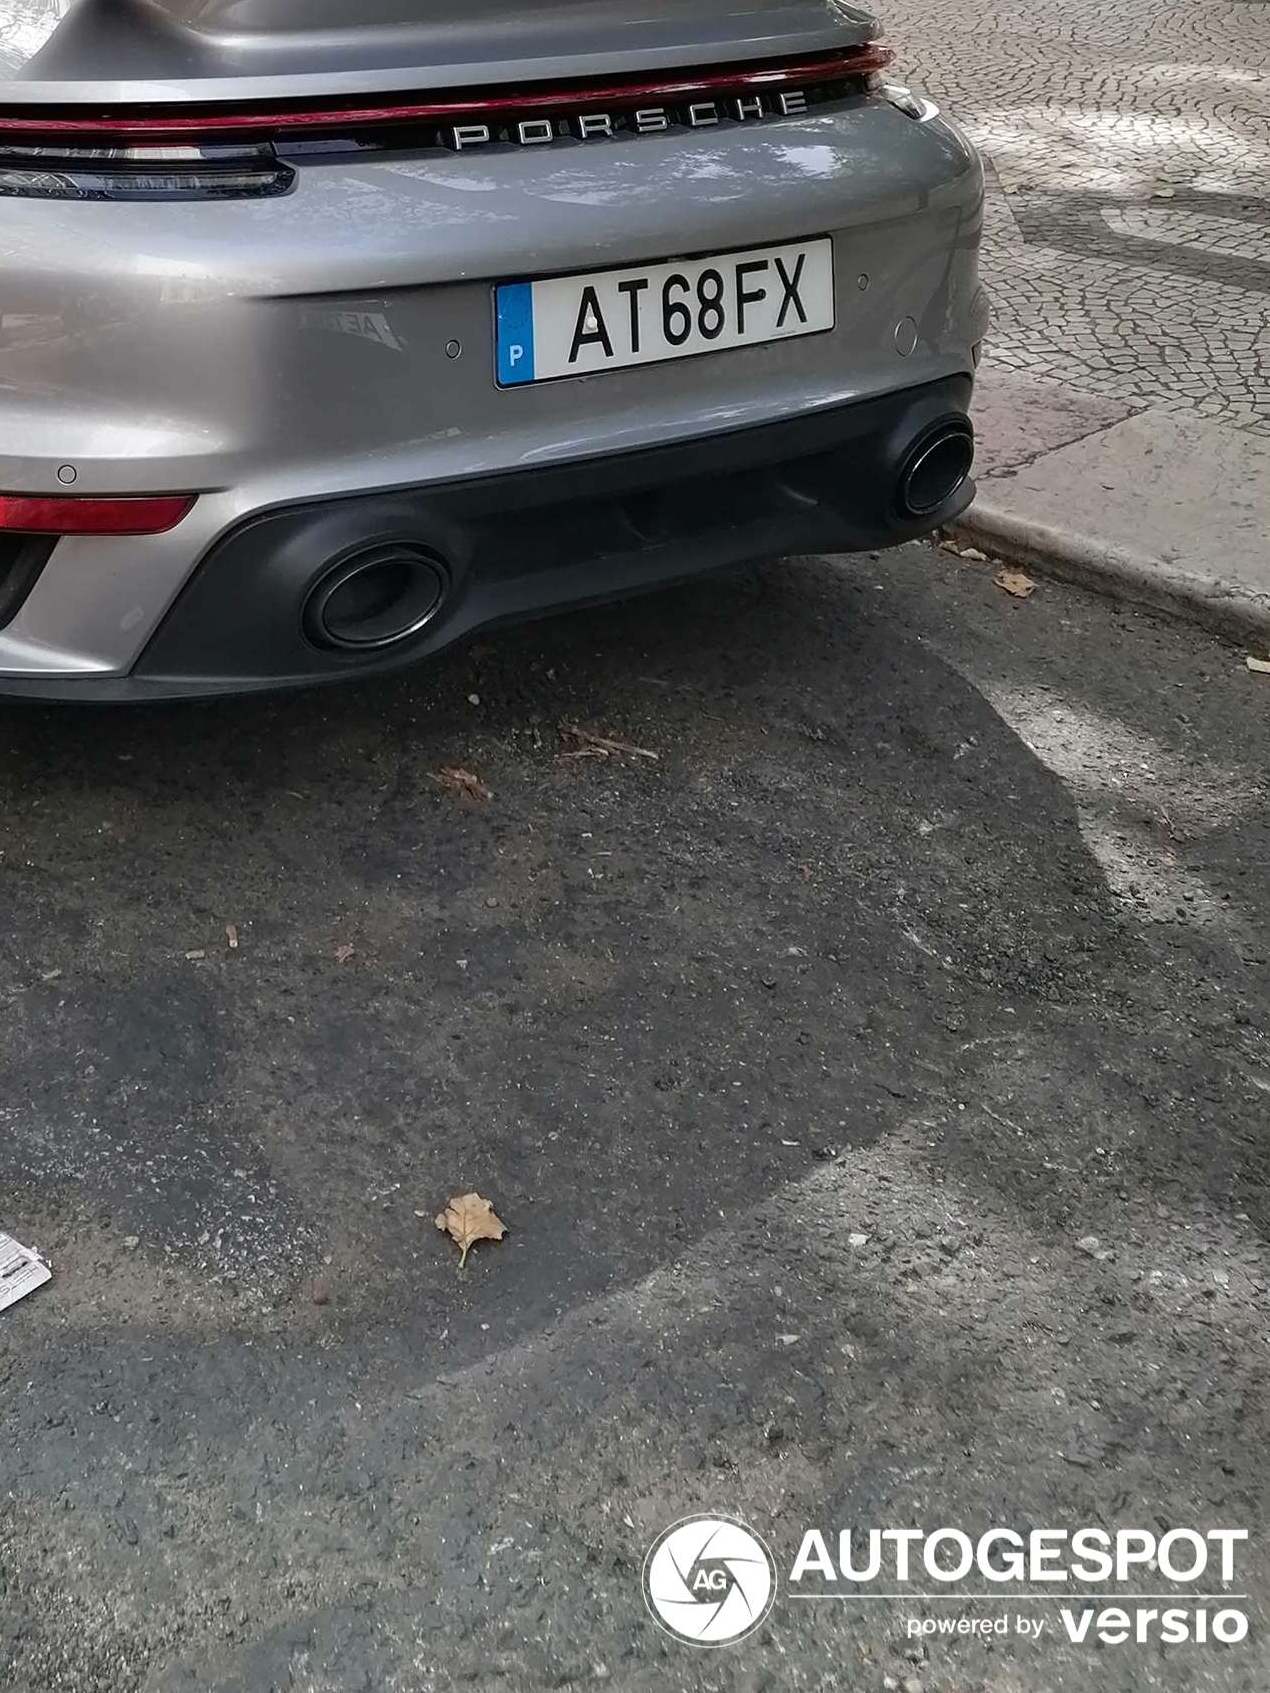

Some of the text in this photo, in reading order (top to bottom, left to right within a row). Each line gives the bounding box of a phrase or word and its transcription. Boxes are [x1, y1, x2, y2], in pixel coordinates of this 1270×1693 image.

[453, 91, 807, 150] PORSCHE
[568, 253, 807, 363] AT68FX
[509, 345, 524, 366] P
